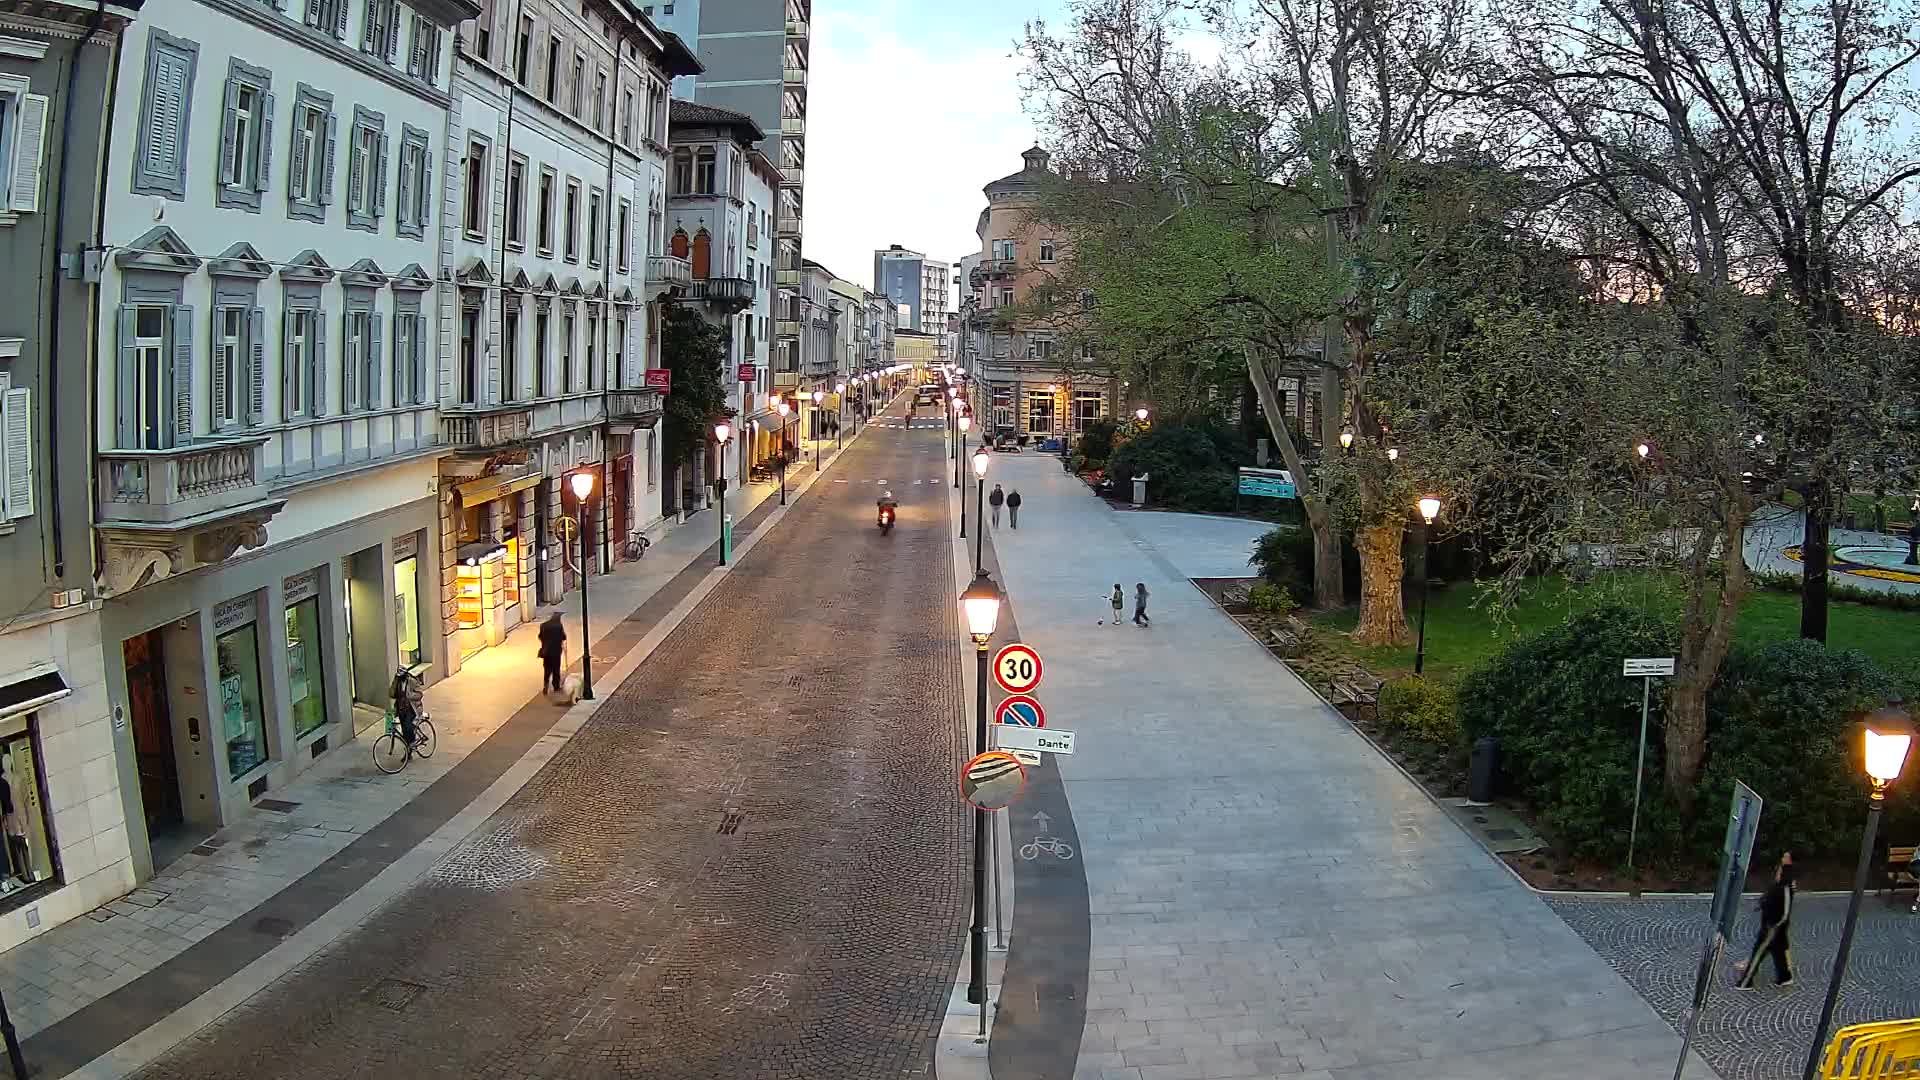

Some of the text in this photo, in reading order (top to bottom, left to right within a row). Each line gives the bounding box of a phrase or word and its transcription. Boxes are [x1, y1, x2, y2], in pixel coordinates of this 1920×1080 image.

[1005, 658, 1033, 680] 30
[221, 677, 240, 700] 130
[1038, 738, 1069, 749] Dante
